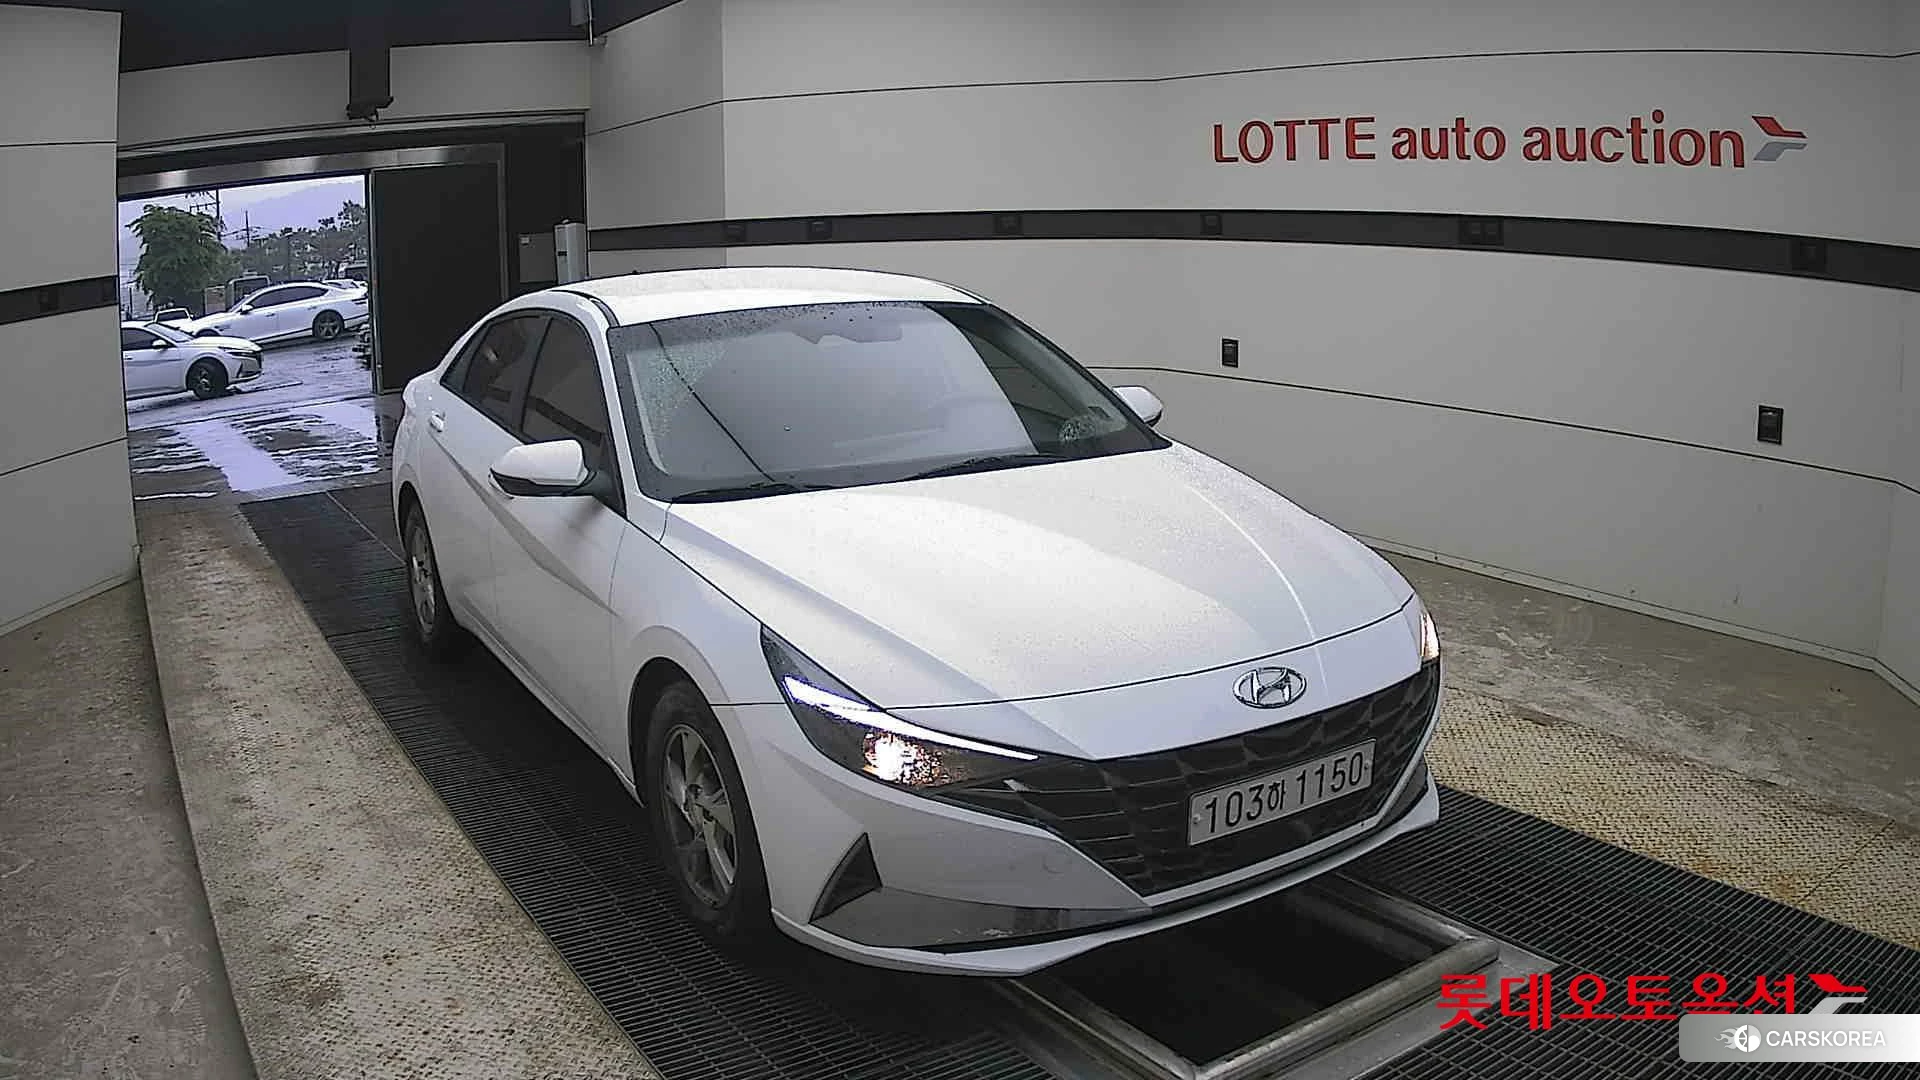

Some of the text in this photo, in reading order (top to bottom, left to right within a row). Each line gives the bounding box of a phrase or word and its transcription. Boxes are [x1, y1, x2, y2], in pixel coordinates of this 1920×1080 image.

[1212, 109, 1746, 168] LOTTE auto auction
[1205, 751, 1364, 833] 103하 1150
